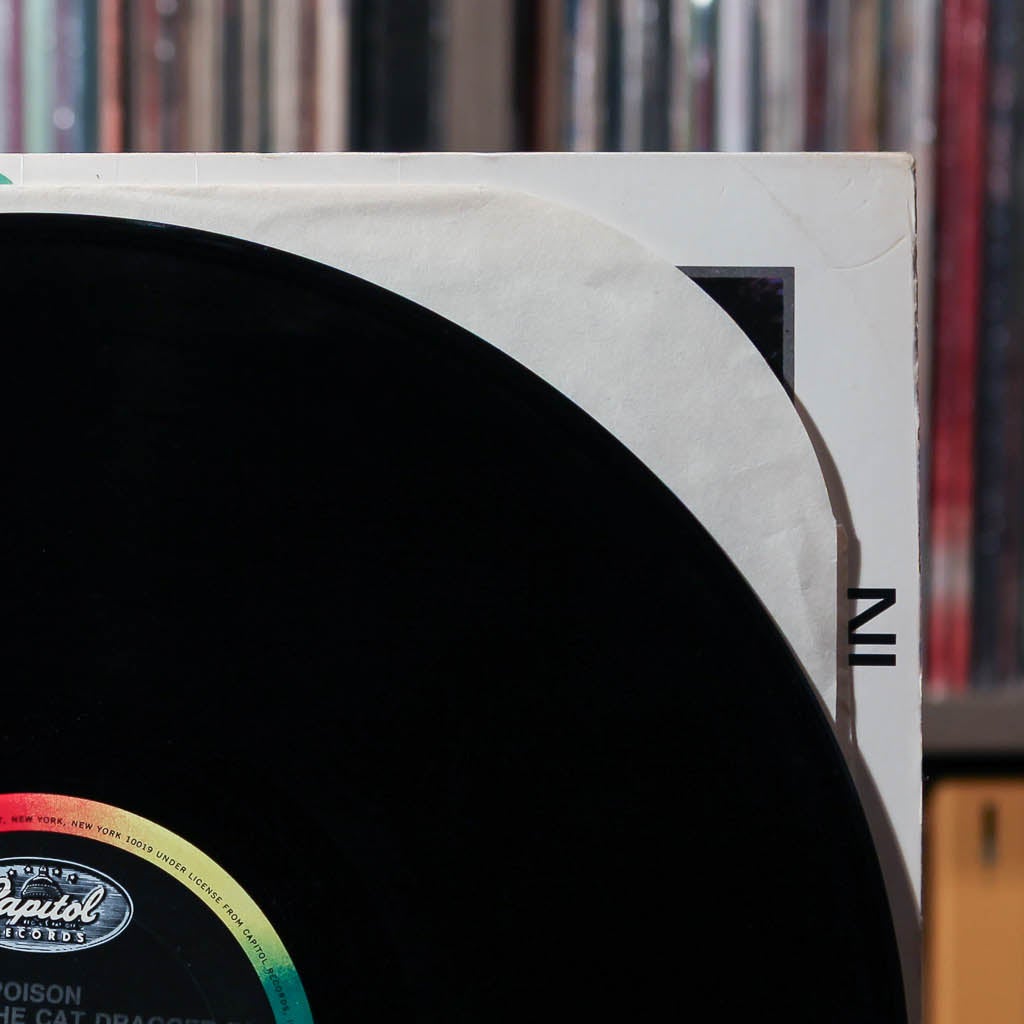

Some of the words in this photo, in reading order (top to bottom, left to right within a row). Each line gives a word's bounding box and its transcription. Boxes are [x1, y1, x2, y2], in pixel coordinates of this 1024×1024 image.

[847, 588, 897, 667] IN
[10, 814, 32, 823] NEW
[37, 814, 67, 826] YORK,
[70, 818, 93, 831] NEW
[96, 824, 123, 840] YORK
[124, 834, 155, 854] 10019
[155, 849, 187, 874] UNDER
[186, 870, 224, 905] LICENSE
[221, 902, 245, 928] FROM
[241, 926, 270, 965] CAPITOL
